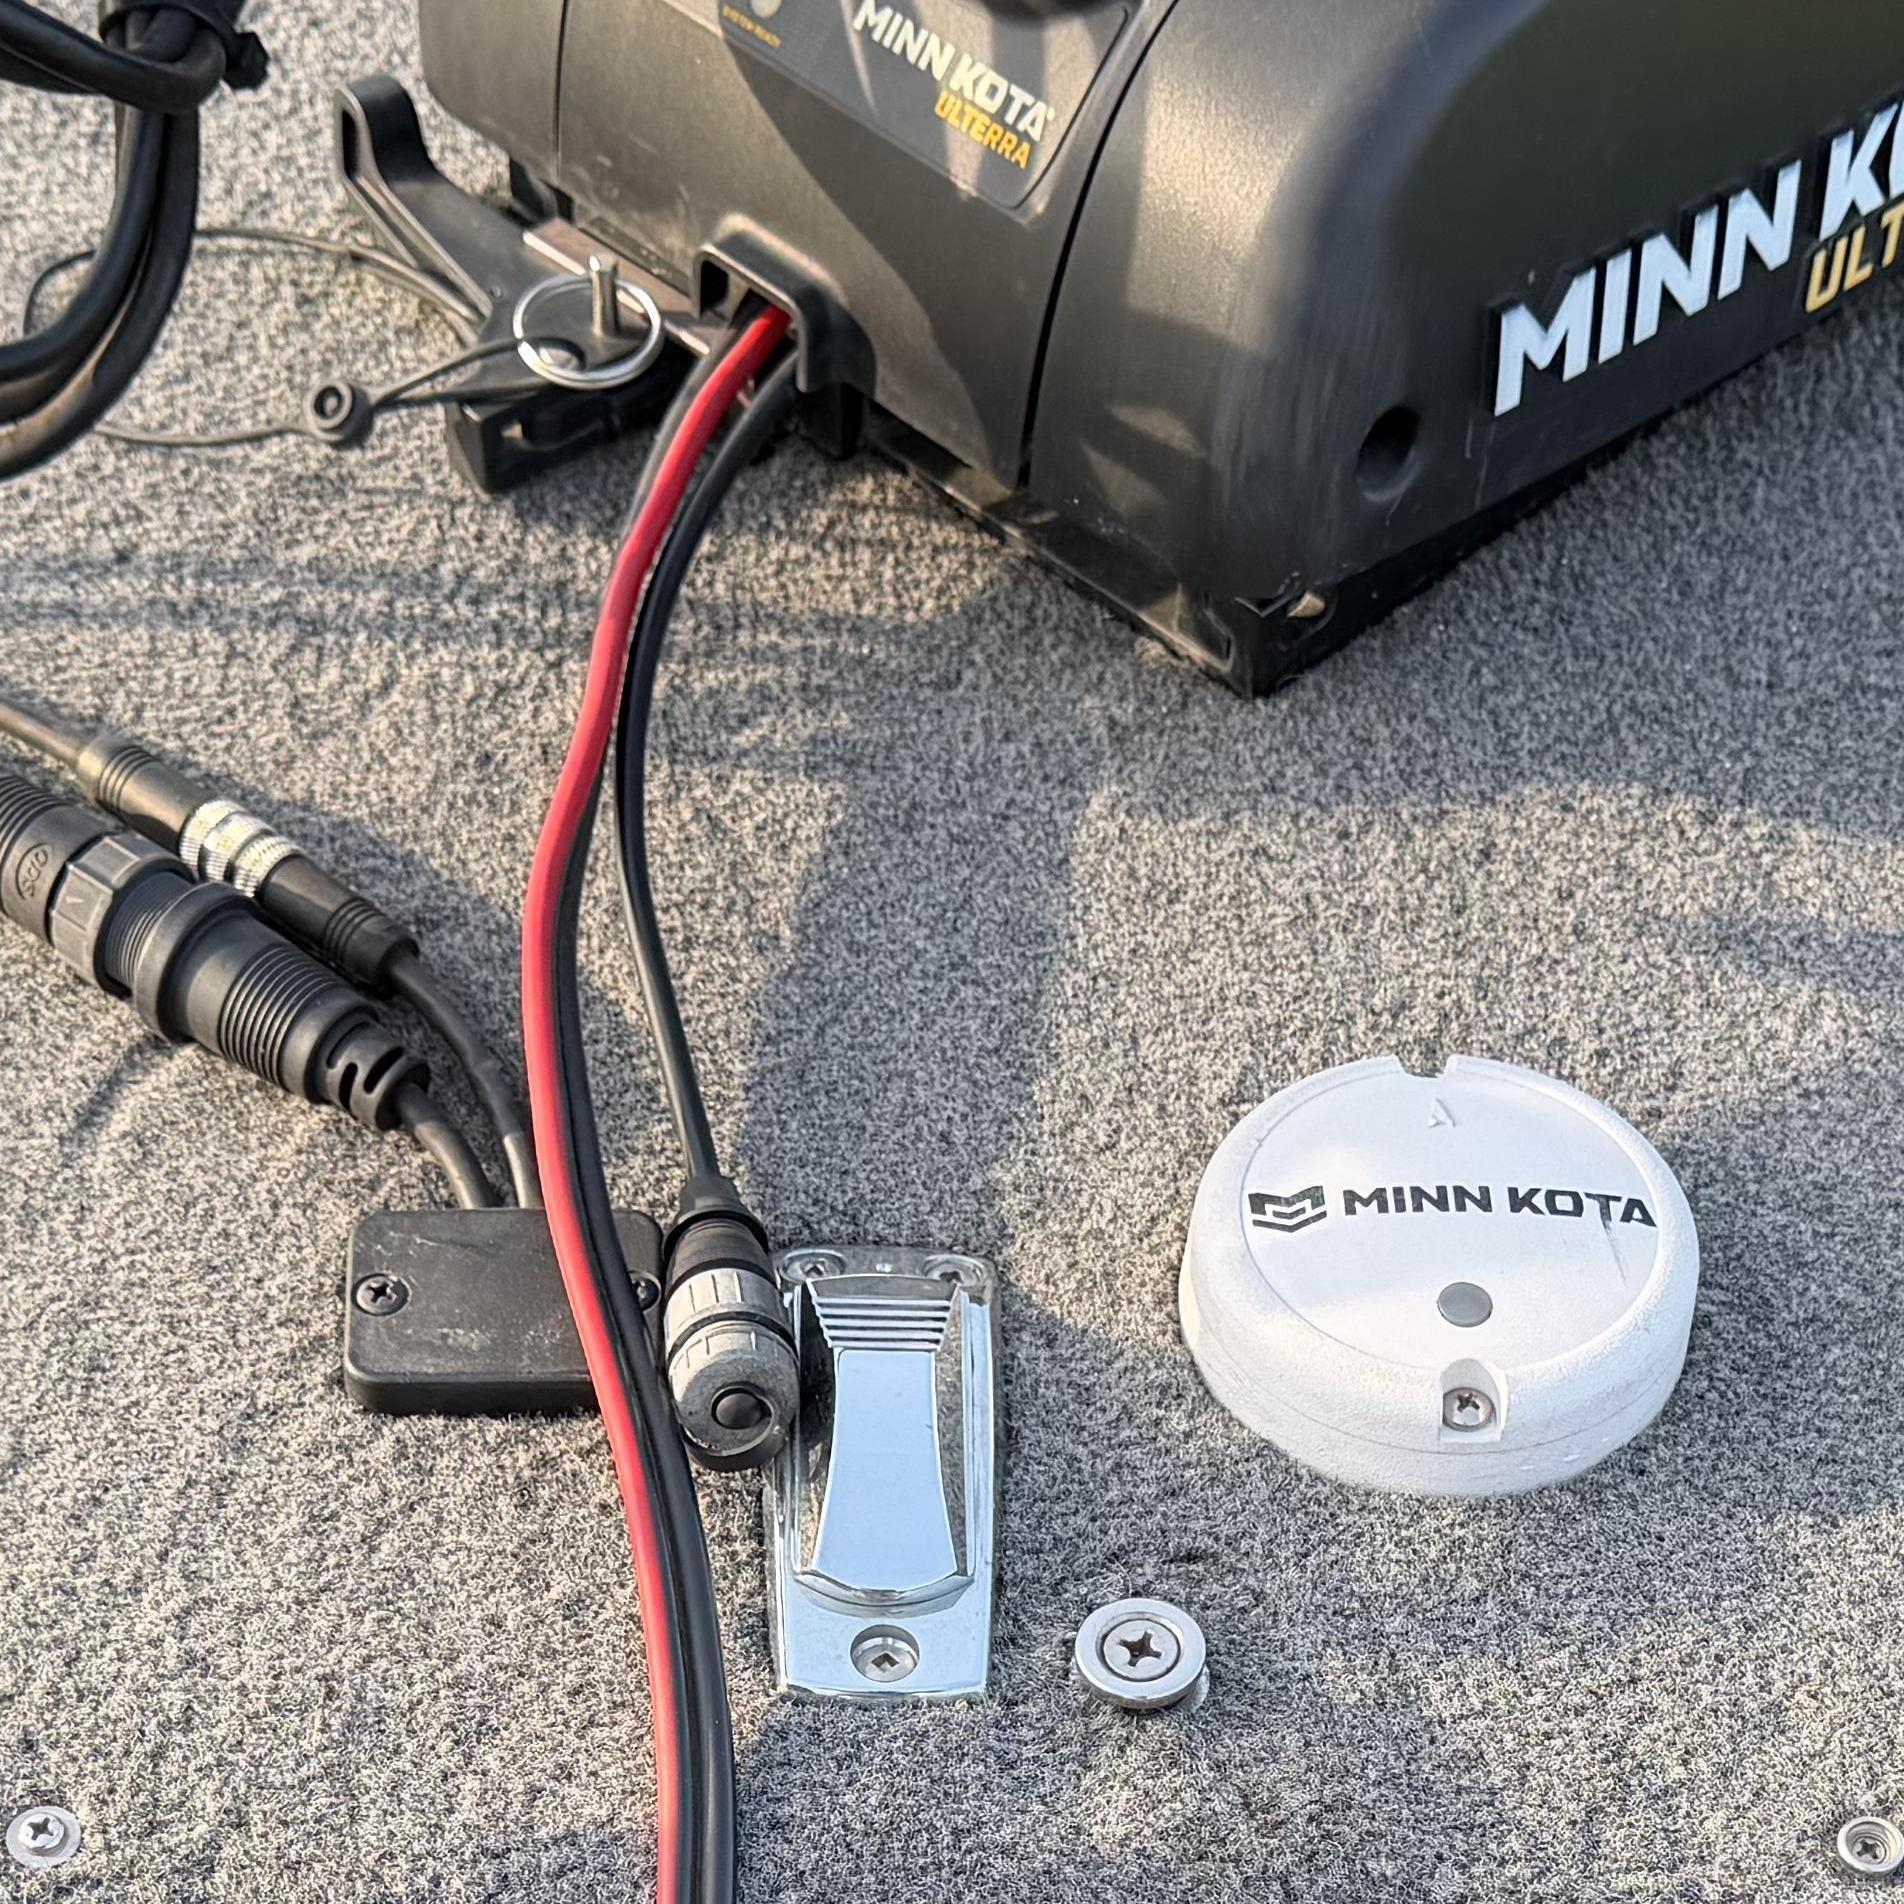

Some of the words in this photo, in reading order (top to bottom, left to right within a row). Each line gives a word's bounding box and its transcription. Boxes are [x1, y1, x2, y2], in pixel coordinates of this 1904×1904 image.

[853, 0, 955, 81] MINN
[950, 53, 1047, 142] KOTA
[934, 90, 1031, 170] ULTERRA
[1495, 160, 1802, 417] MINN
[1342, 1185, 1493, 1216] MINN
[1507, 1186, 1658, 1228] KOTA
